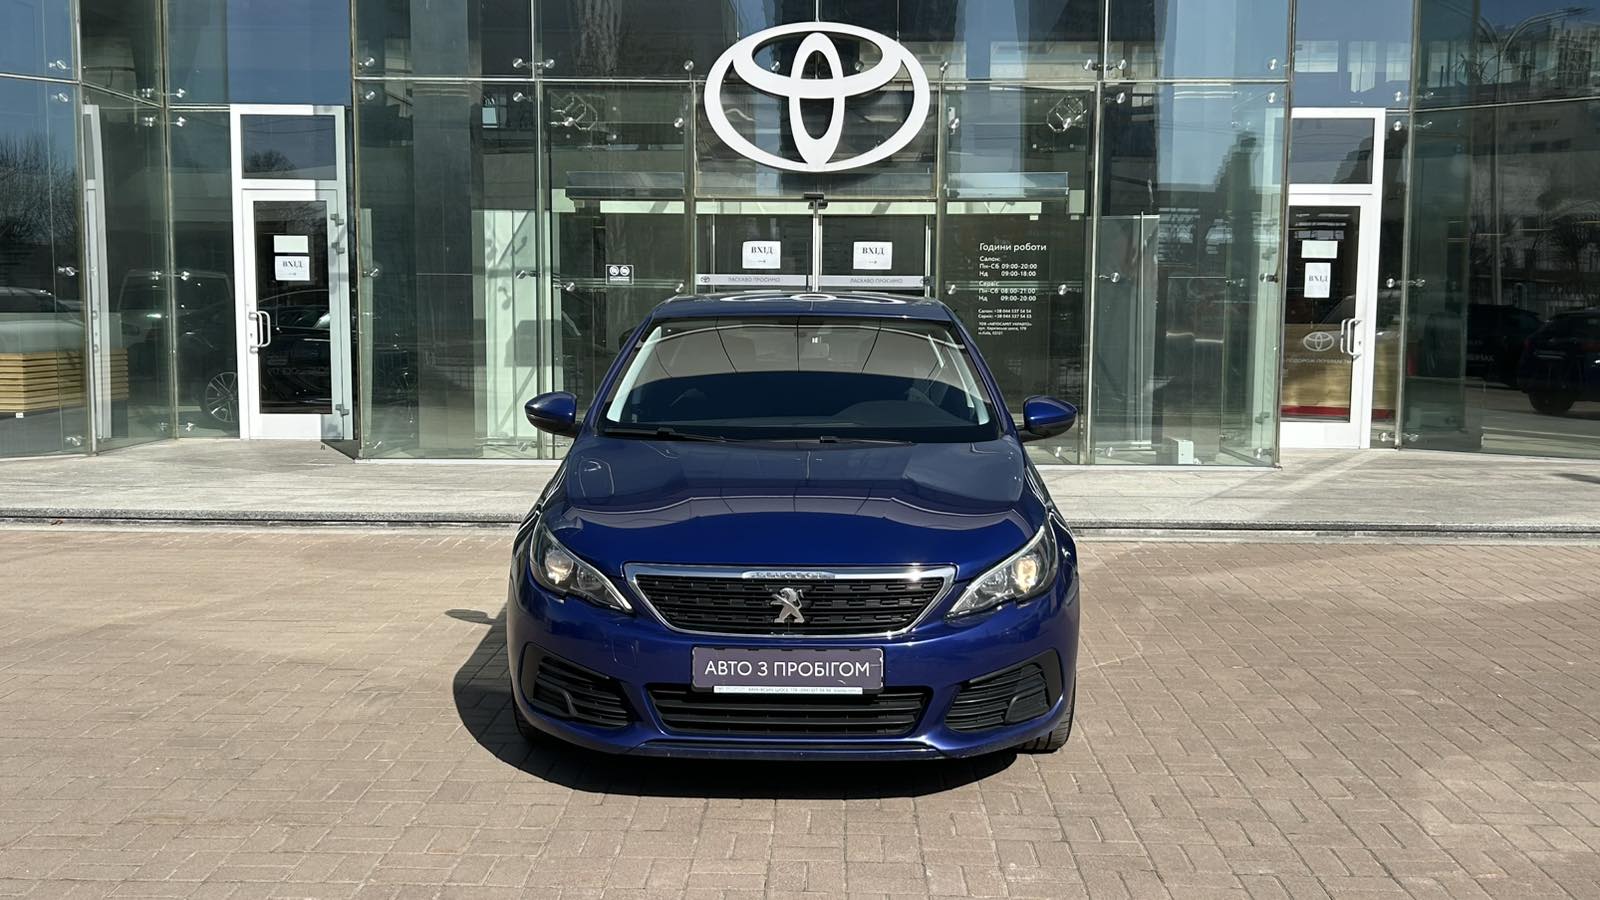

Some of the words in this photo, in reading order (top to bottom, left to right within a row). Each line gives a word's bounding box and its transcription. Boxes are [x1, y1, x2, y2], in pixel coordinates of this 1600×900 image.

[979, 243, 1012, 252] Години
[1013, 243, 1047, 253] роботи
[704, 660, 752, 676] АВТО
[757, 661, 768, 676] З
[774, 661, 870, 677] ПРОБІГОМ
